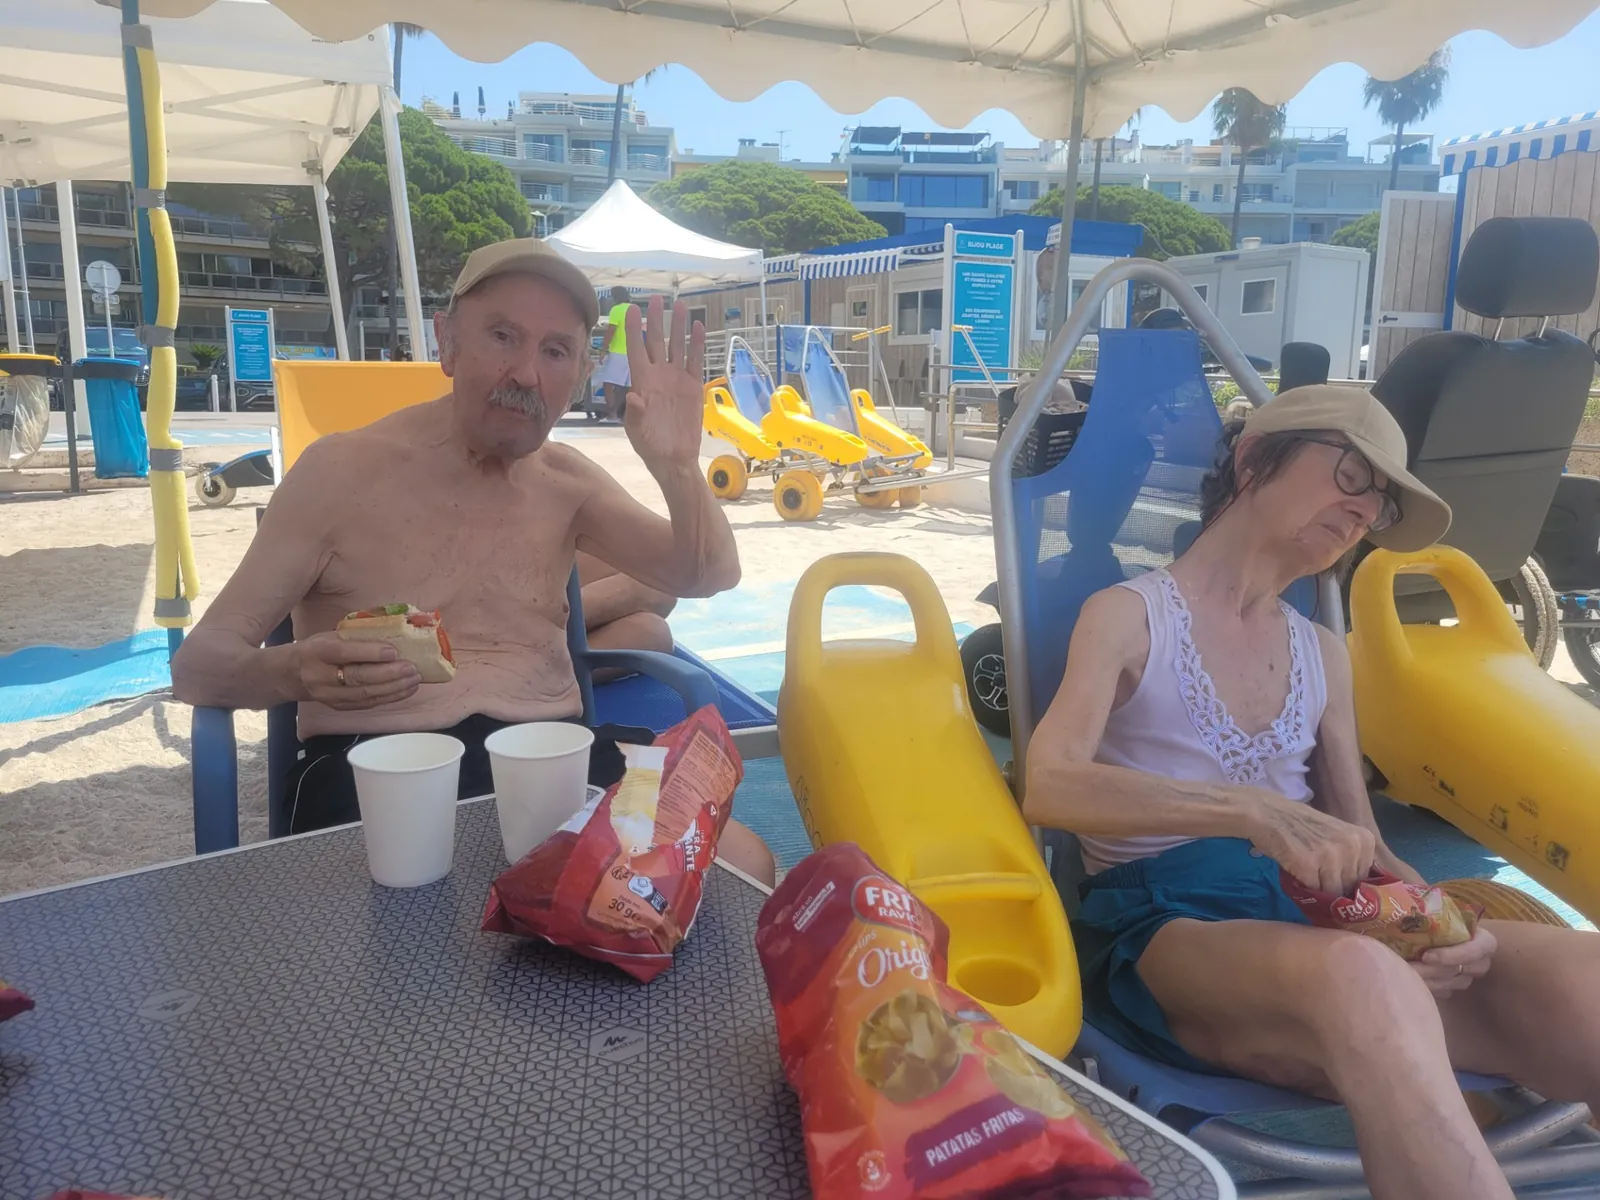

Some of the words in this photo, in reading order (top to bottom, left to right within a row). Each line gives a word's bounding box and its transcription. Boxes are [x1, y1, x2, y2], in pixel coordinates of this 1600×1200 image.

[608, 898, 625, 912] 30
[865, 886, 913, 911] FRI
[878, 906, 920, 923] RAVIC
[925, 1126, 983, 1168] PATATAS
[981, 1107, 1025, 1139] FRITAS
